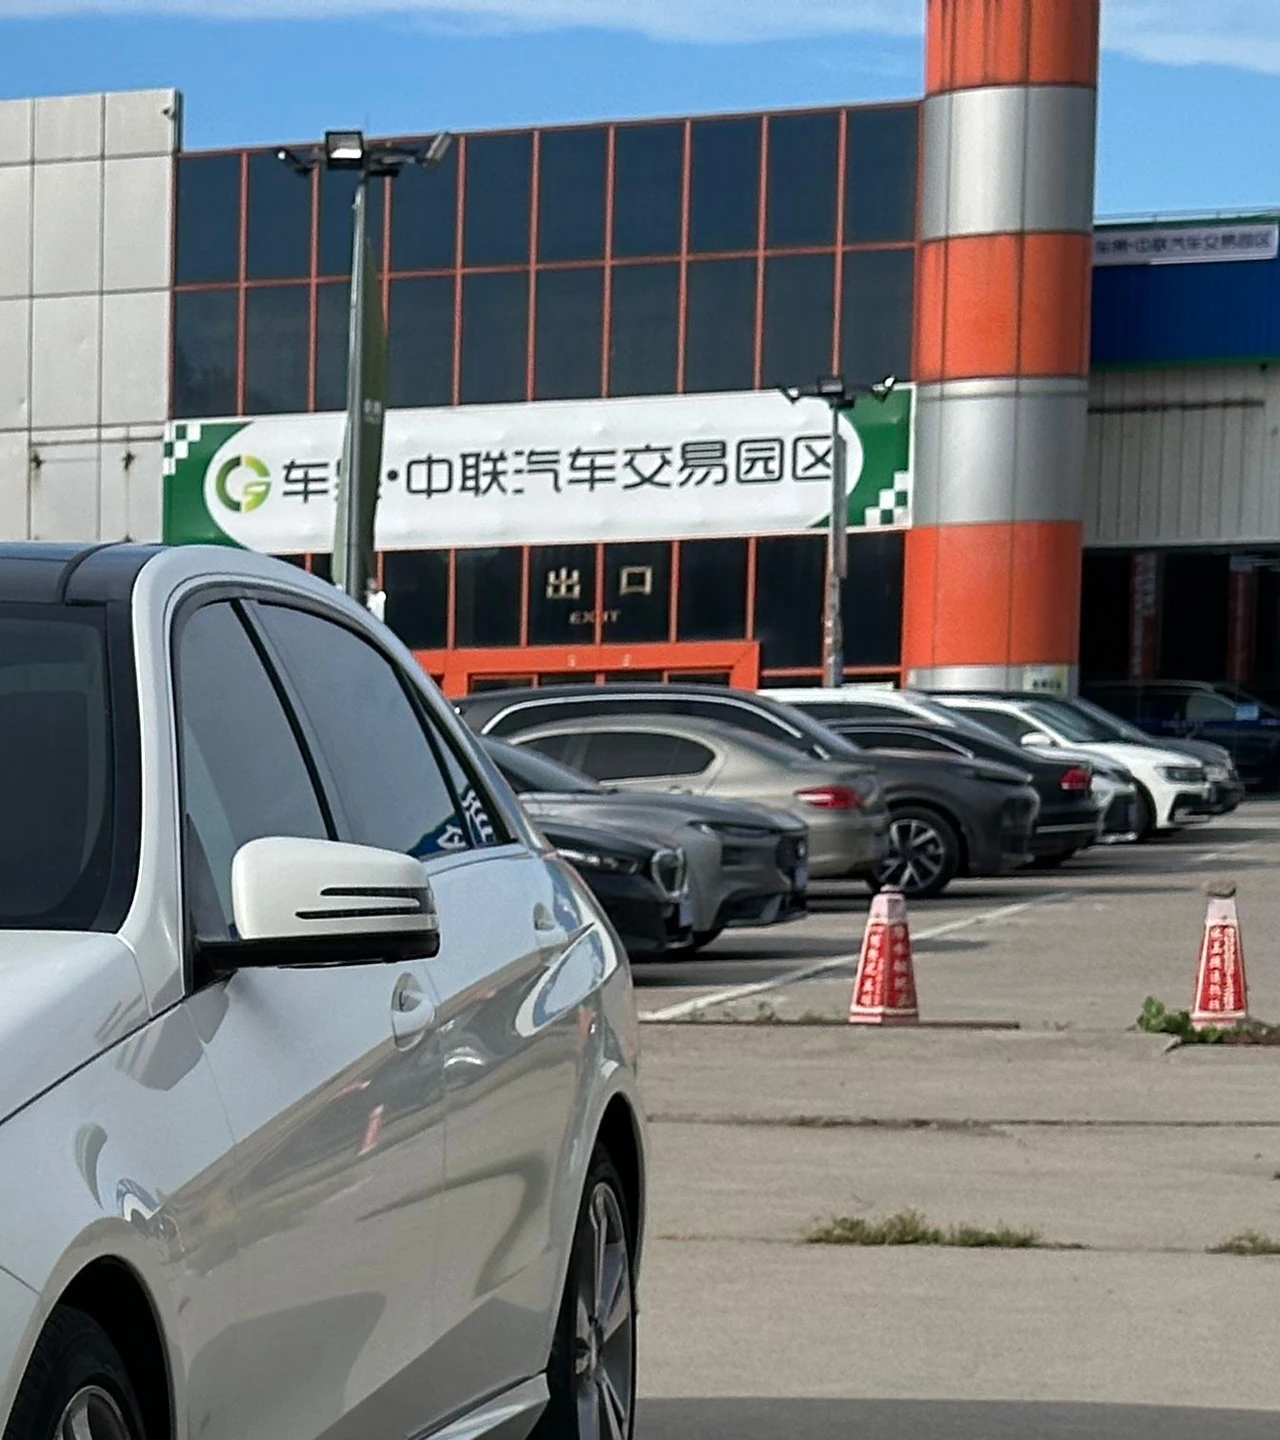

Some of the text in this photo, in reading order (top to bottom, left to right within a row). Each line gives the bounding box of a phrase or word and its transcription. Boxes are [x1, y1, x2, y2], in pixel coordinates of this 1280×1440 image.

[282, 433, 832, 504] 车·中联汽车交易园区
[546, 566, 653, 599] 出口
